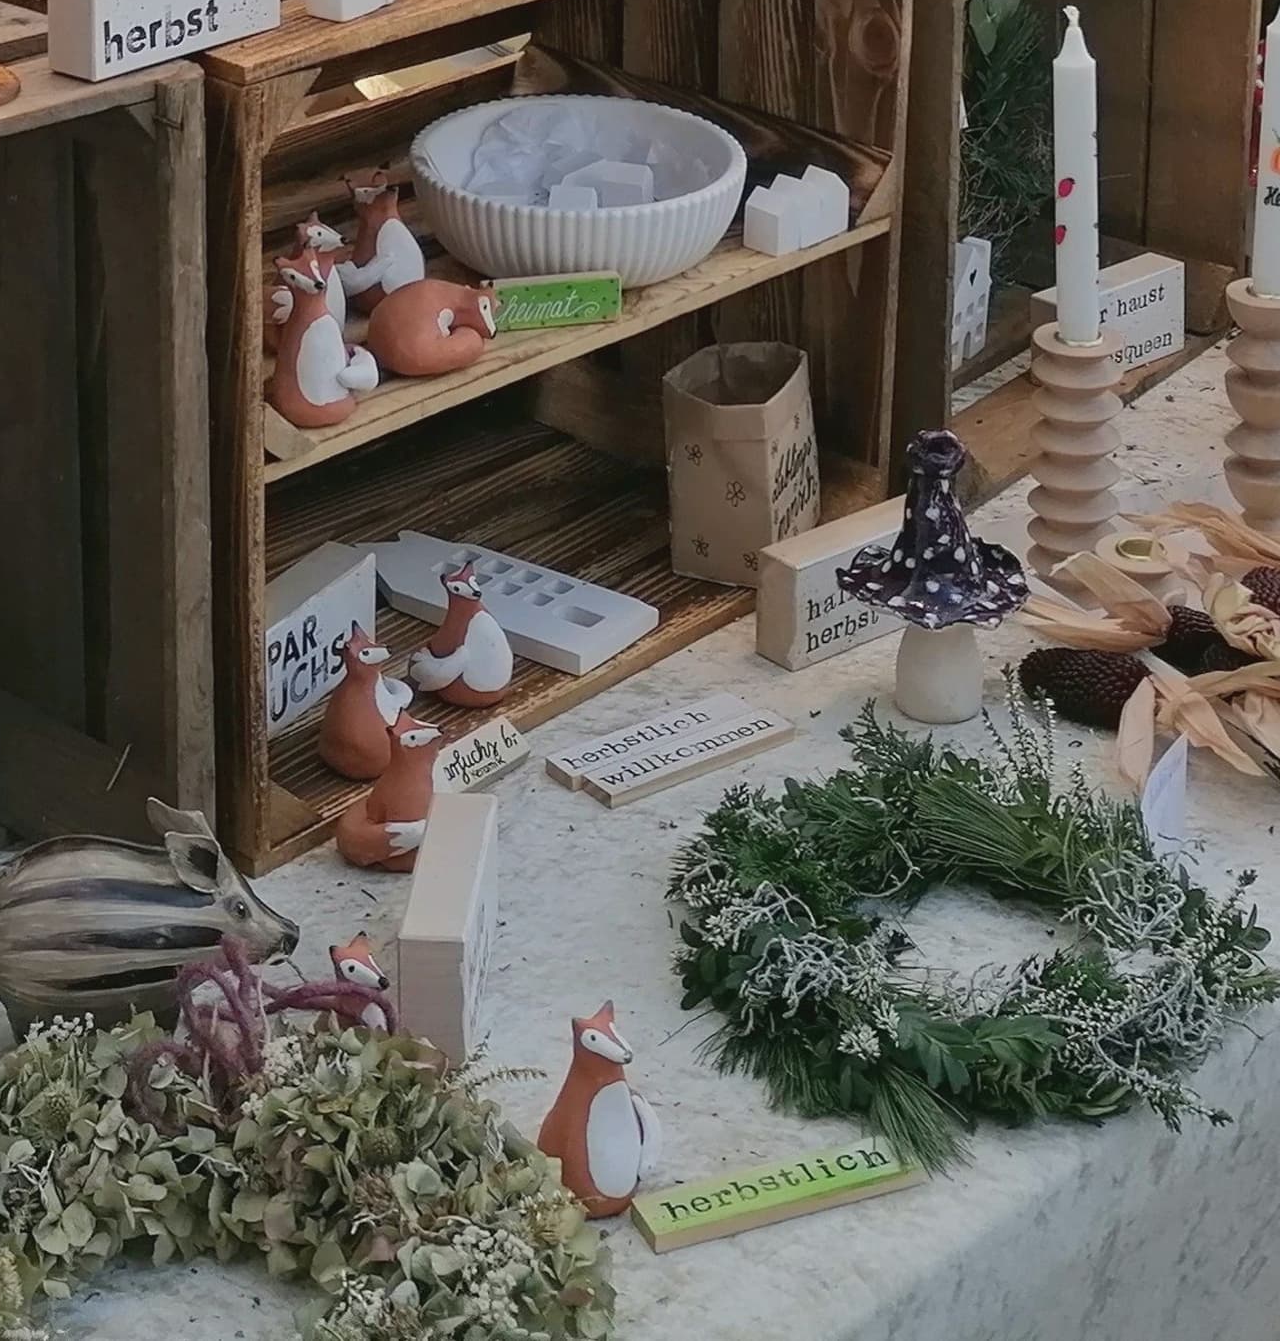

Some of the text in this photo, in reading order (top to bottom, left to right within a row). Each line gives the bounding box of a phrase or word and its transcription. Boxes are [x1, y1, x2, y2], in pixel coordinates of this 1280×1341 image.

[494, 289, 600, 324] heimat
[1116, 283, 1165, 317] haust
[1108, 332, 1173, 364] squeen
[268, 614, 318, 671] PAR
[270, 632, 345, 723] UCHS
[562, 710, 712, 770] herbstlich
[599, 717, 775, 787] willkommen
[659, 1148, 890, 1223] herbstlich
